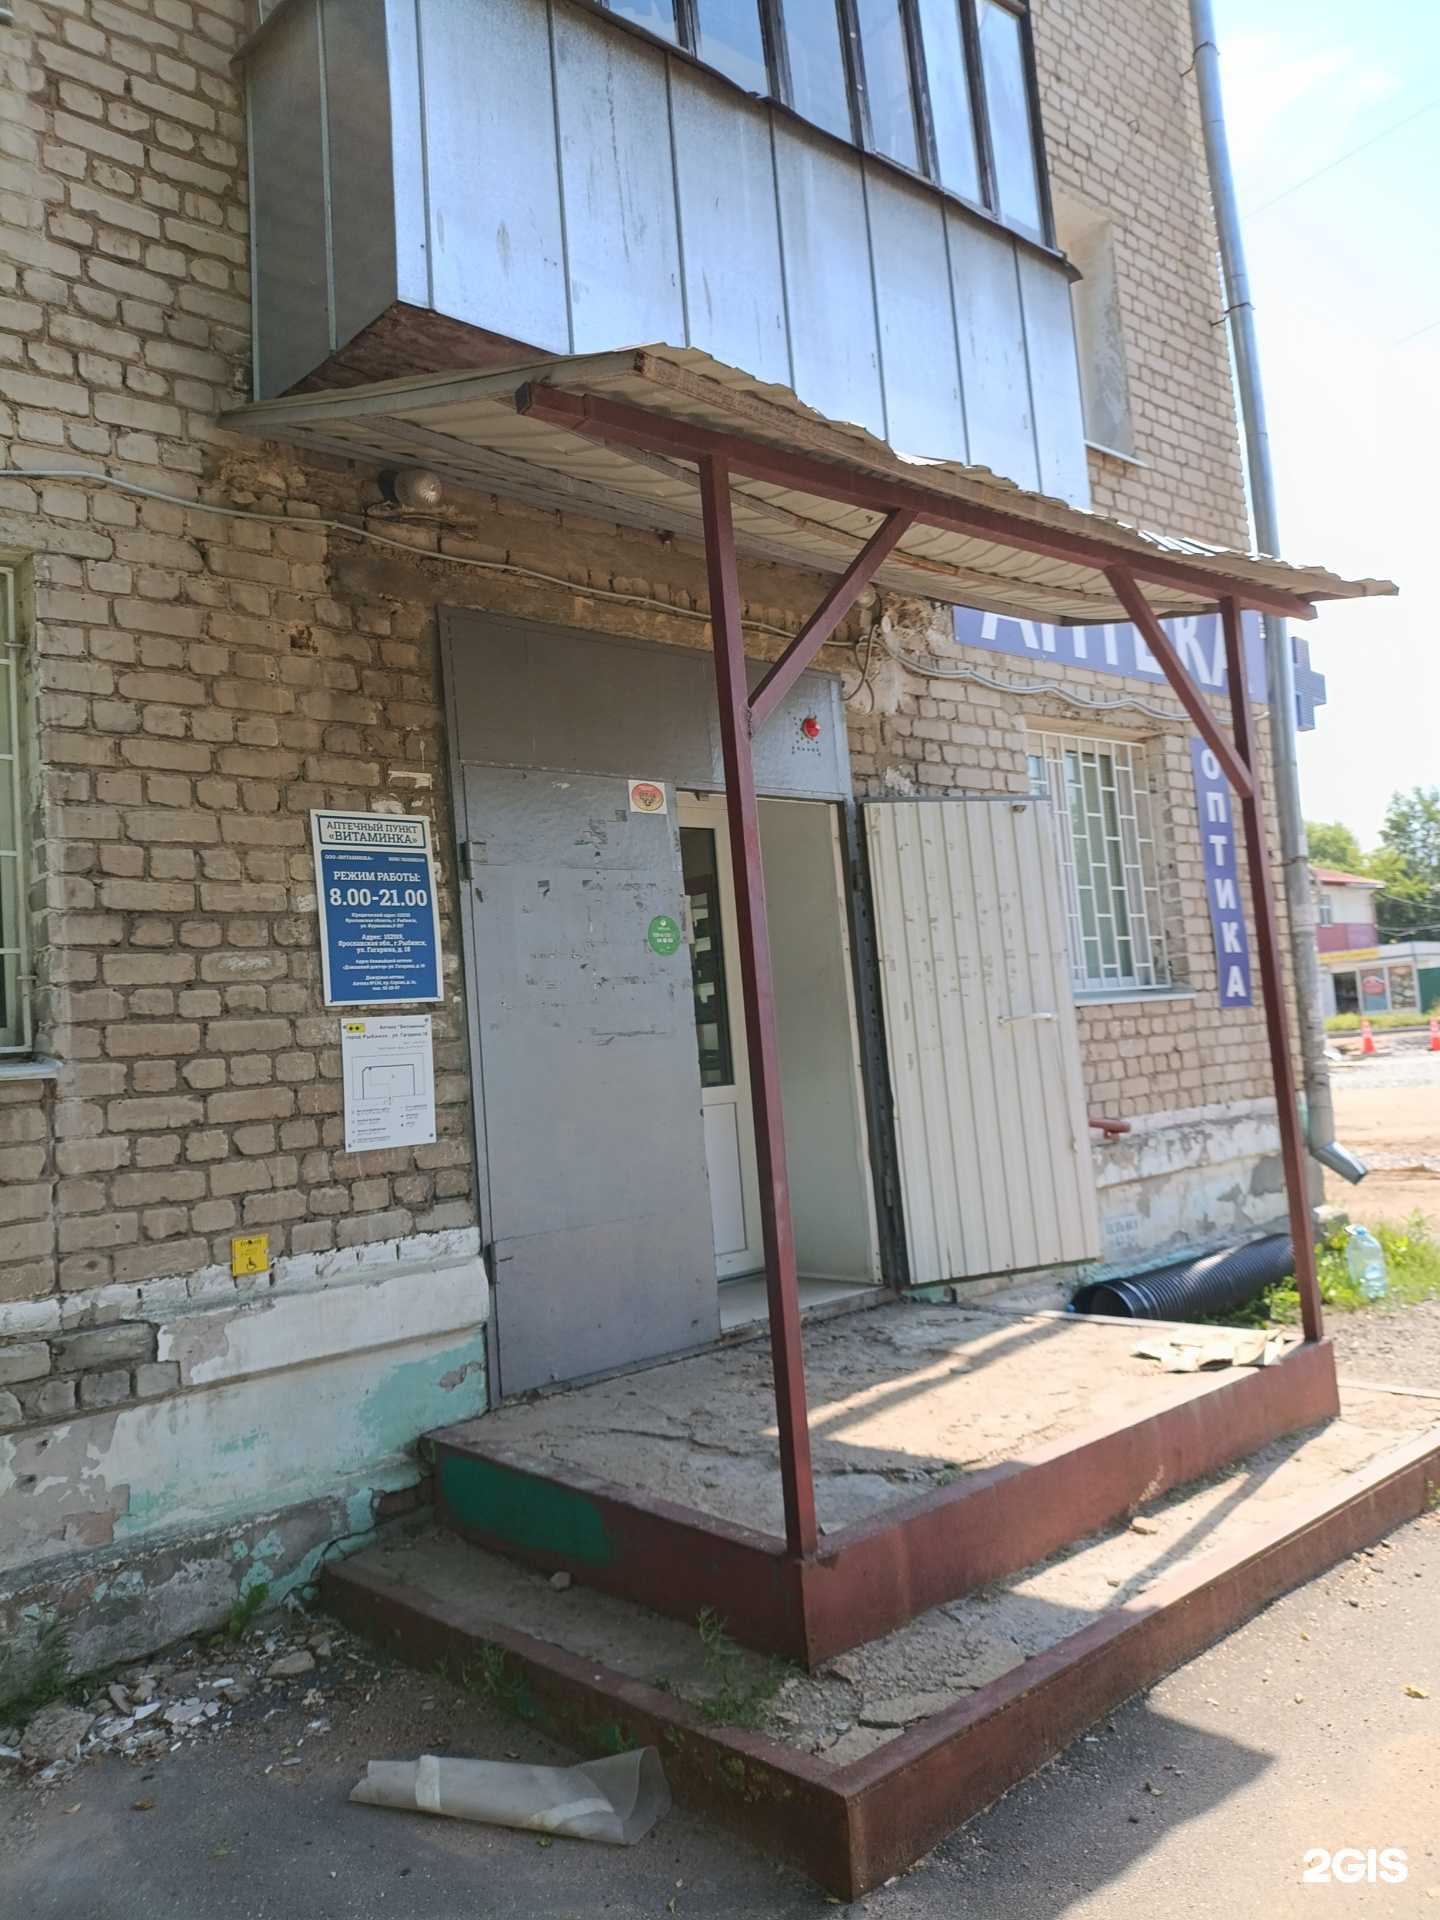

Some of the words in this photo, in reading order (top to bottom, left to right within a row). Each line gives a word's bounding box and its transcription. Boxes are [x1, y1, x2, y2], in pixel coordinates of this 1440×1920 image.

[326, 821, 384, 832] АПТЕЧНЫЙ
[385, 824, 418, 834] ПУНКТ
[329, 831, 417, 843] «ВИТАМИНКА»
[333, 871, 375, 881] РЕЖИМ
[376, 872, 421, 882] РАБОТЫ:
[1201, 748, 1247, 998] ОПТИКА
[329, 888, 428, 907] 8.00-21.00
